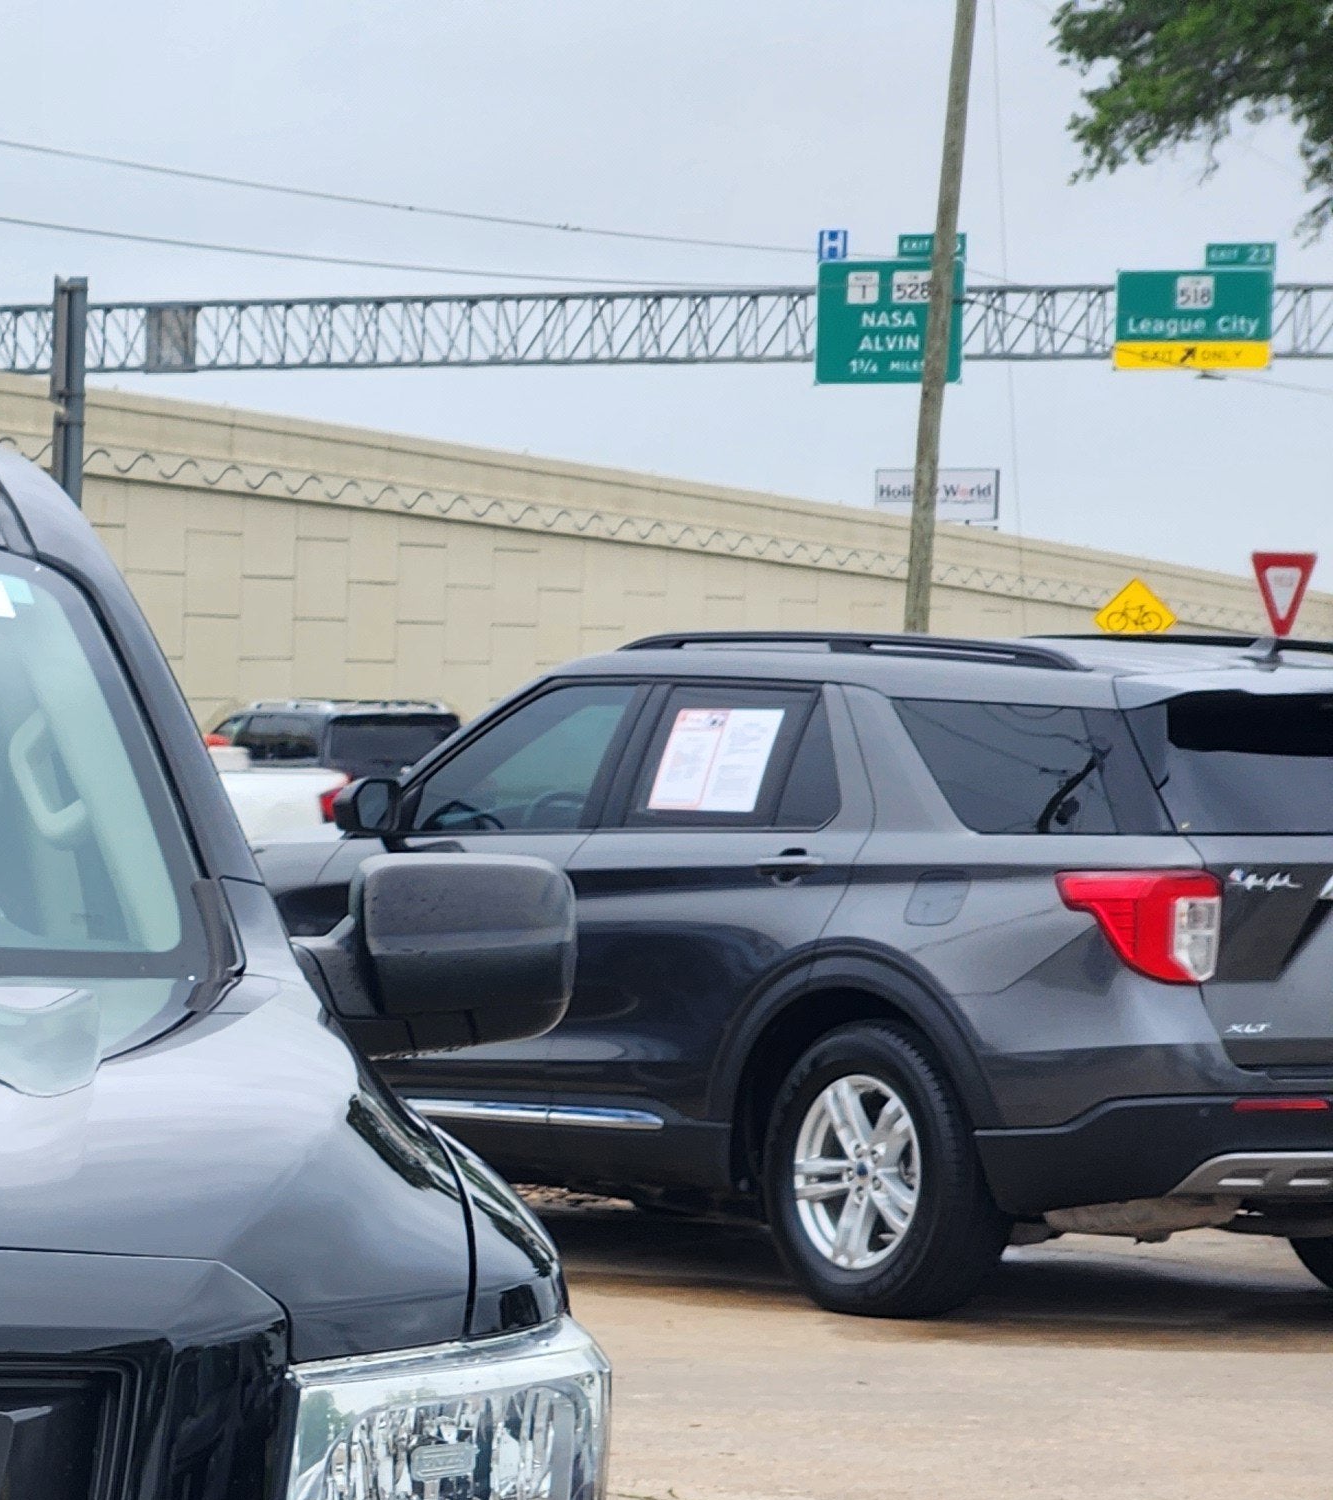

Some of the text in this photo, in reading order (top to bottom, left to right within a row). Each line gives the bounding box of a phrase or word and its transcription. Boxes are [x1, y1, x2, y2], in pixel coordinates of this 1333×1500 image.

[902, 238, 931, 250] EXIT
[896, 282, 933, 301] 528
[1179, 287, 1212, 306] 518
[860, 310, 917, 328] NASA
[1127, 314, 1260, 338] League City
[858, 334, 921, 351] ALVIN
[942, 482, 992, 498] World
[1225, 1022, 1272, 1034] XLT
